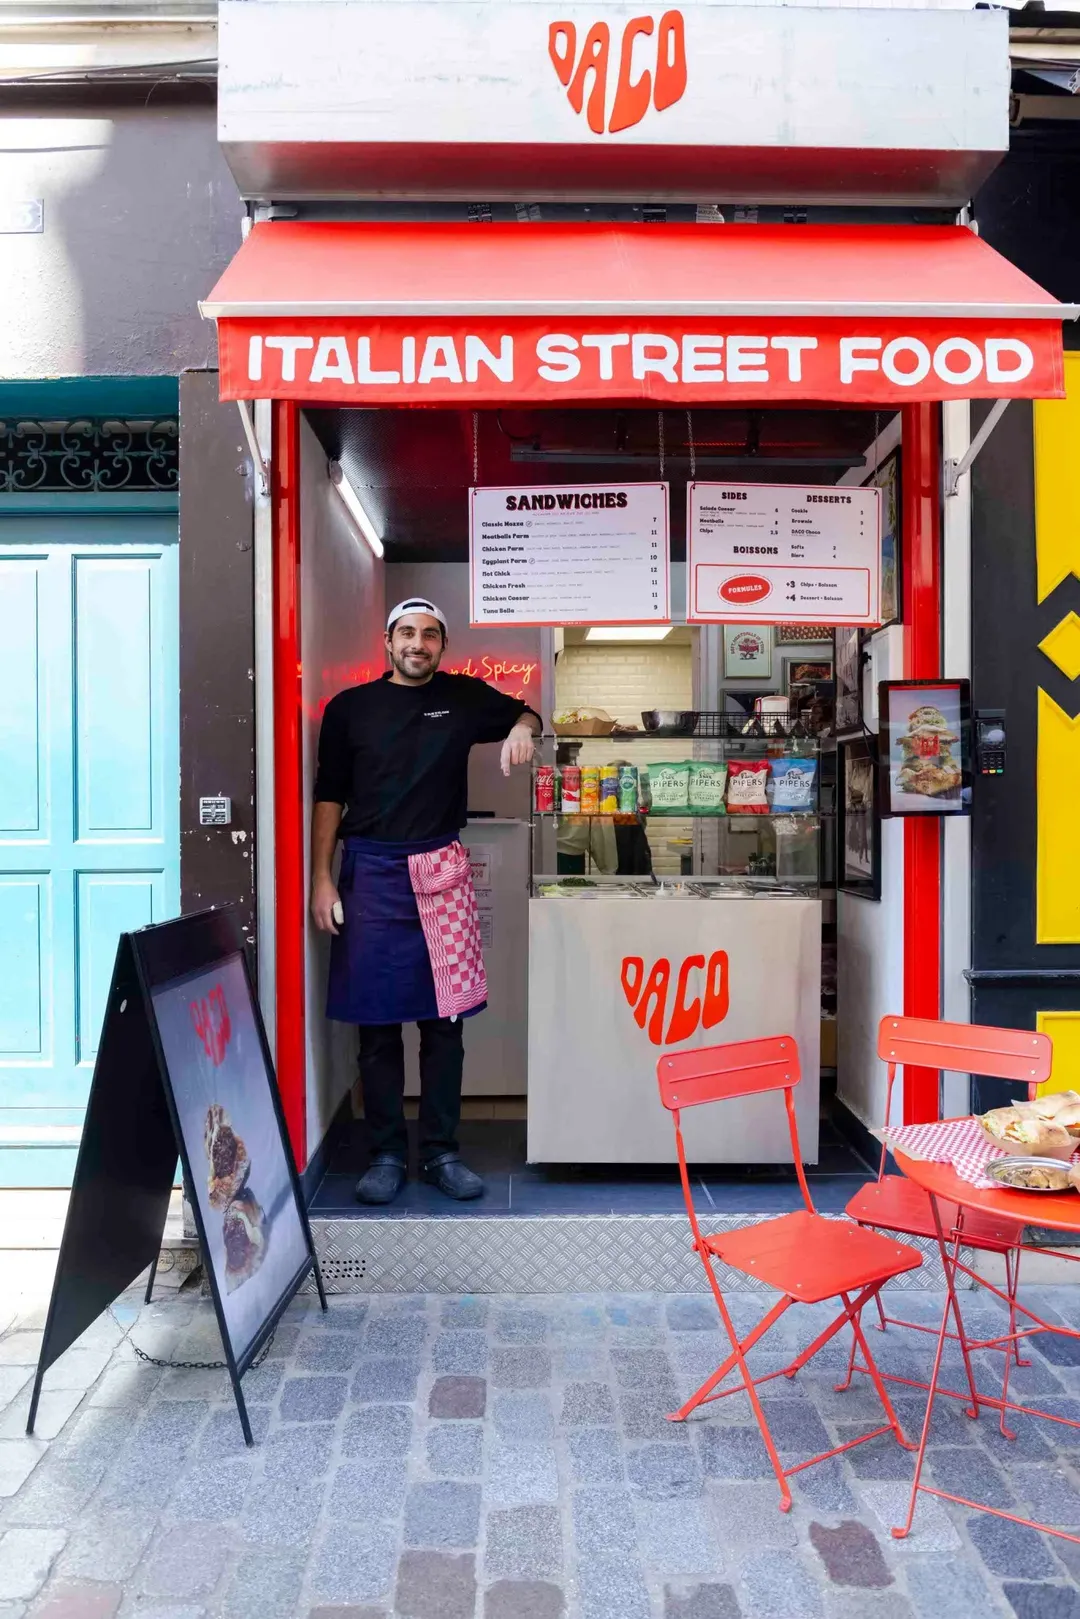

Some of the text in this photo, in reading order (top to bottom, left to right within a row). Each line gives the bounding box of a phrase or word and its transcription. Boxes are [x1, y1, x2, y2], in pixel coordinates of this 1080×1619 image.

[548, 10, 687, 134] DACO
[248, 334, 1034, 385] ITALIAN STREET FOOD
[722, 492, 747, 500] SIDES
[806, 495, 852, 504] DESSERTS
[506, 492, 628, 510] SANDWICHES
[733, 546, 779, 555] BOISSONS
[728, 584, 763, 594] FORMULES
[482, 656, 537, 684] Spicy
[653, 779, 685, 788] PIPERS
[690, 779, 721, 787] PIPERS
[732, 779, 762, 787] PIPERS
[780, 779, 810, 788] PIPERS
[620, 949, 730, 1045] DACO
